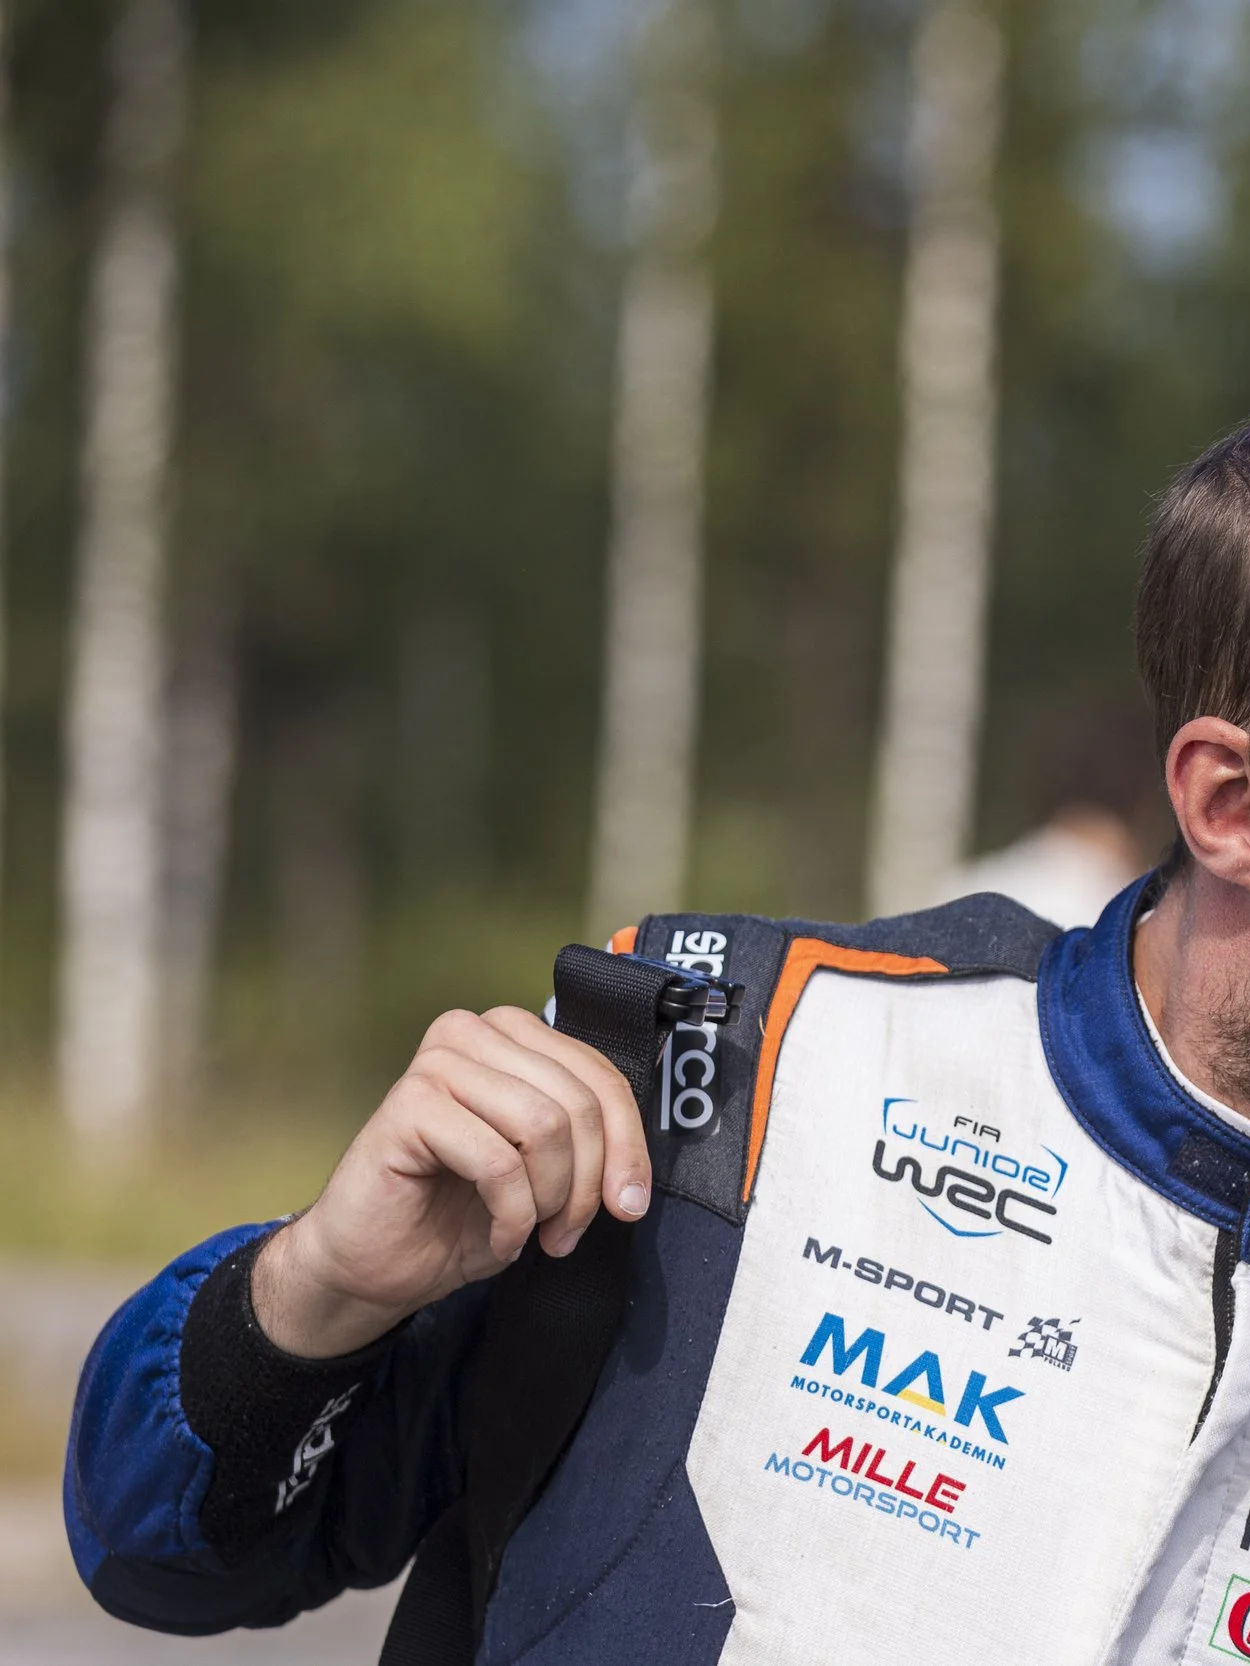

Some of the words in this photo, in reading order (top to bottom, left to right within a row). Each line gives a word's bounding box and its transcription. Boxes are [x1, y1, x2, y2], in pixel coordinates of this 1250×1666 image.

[661, 930, 728, 1130] sprco
[893, 1123, 1051, 1192] JUNIOR
[953, 1115, 1001, 1143] FIA
[872, 1139, 1058, 1245] WRC
[802, 1236, 1004, 1332] M-SPORT
[790, 1374, 1007, 1470] MOTORSPORTAKADEMIN
[799, 1311, 1027, 1446] MAK
[764, 1452, 982, 1550] MOTORSPORT
[801, 1427, 967, 1513] MILLE
